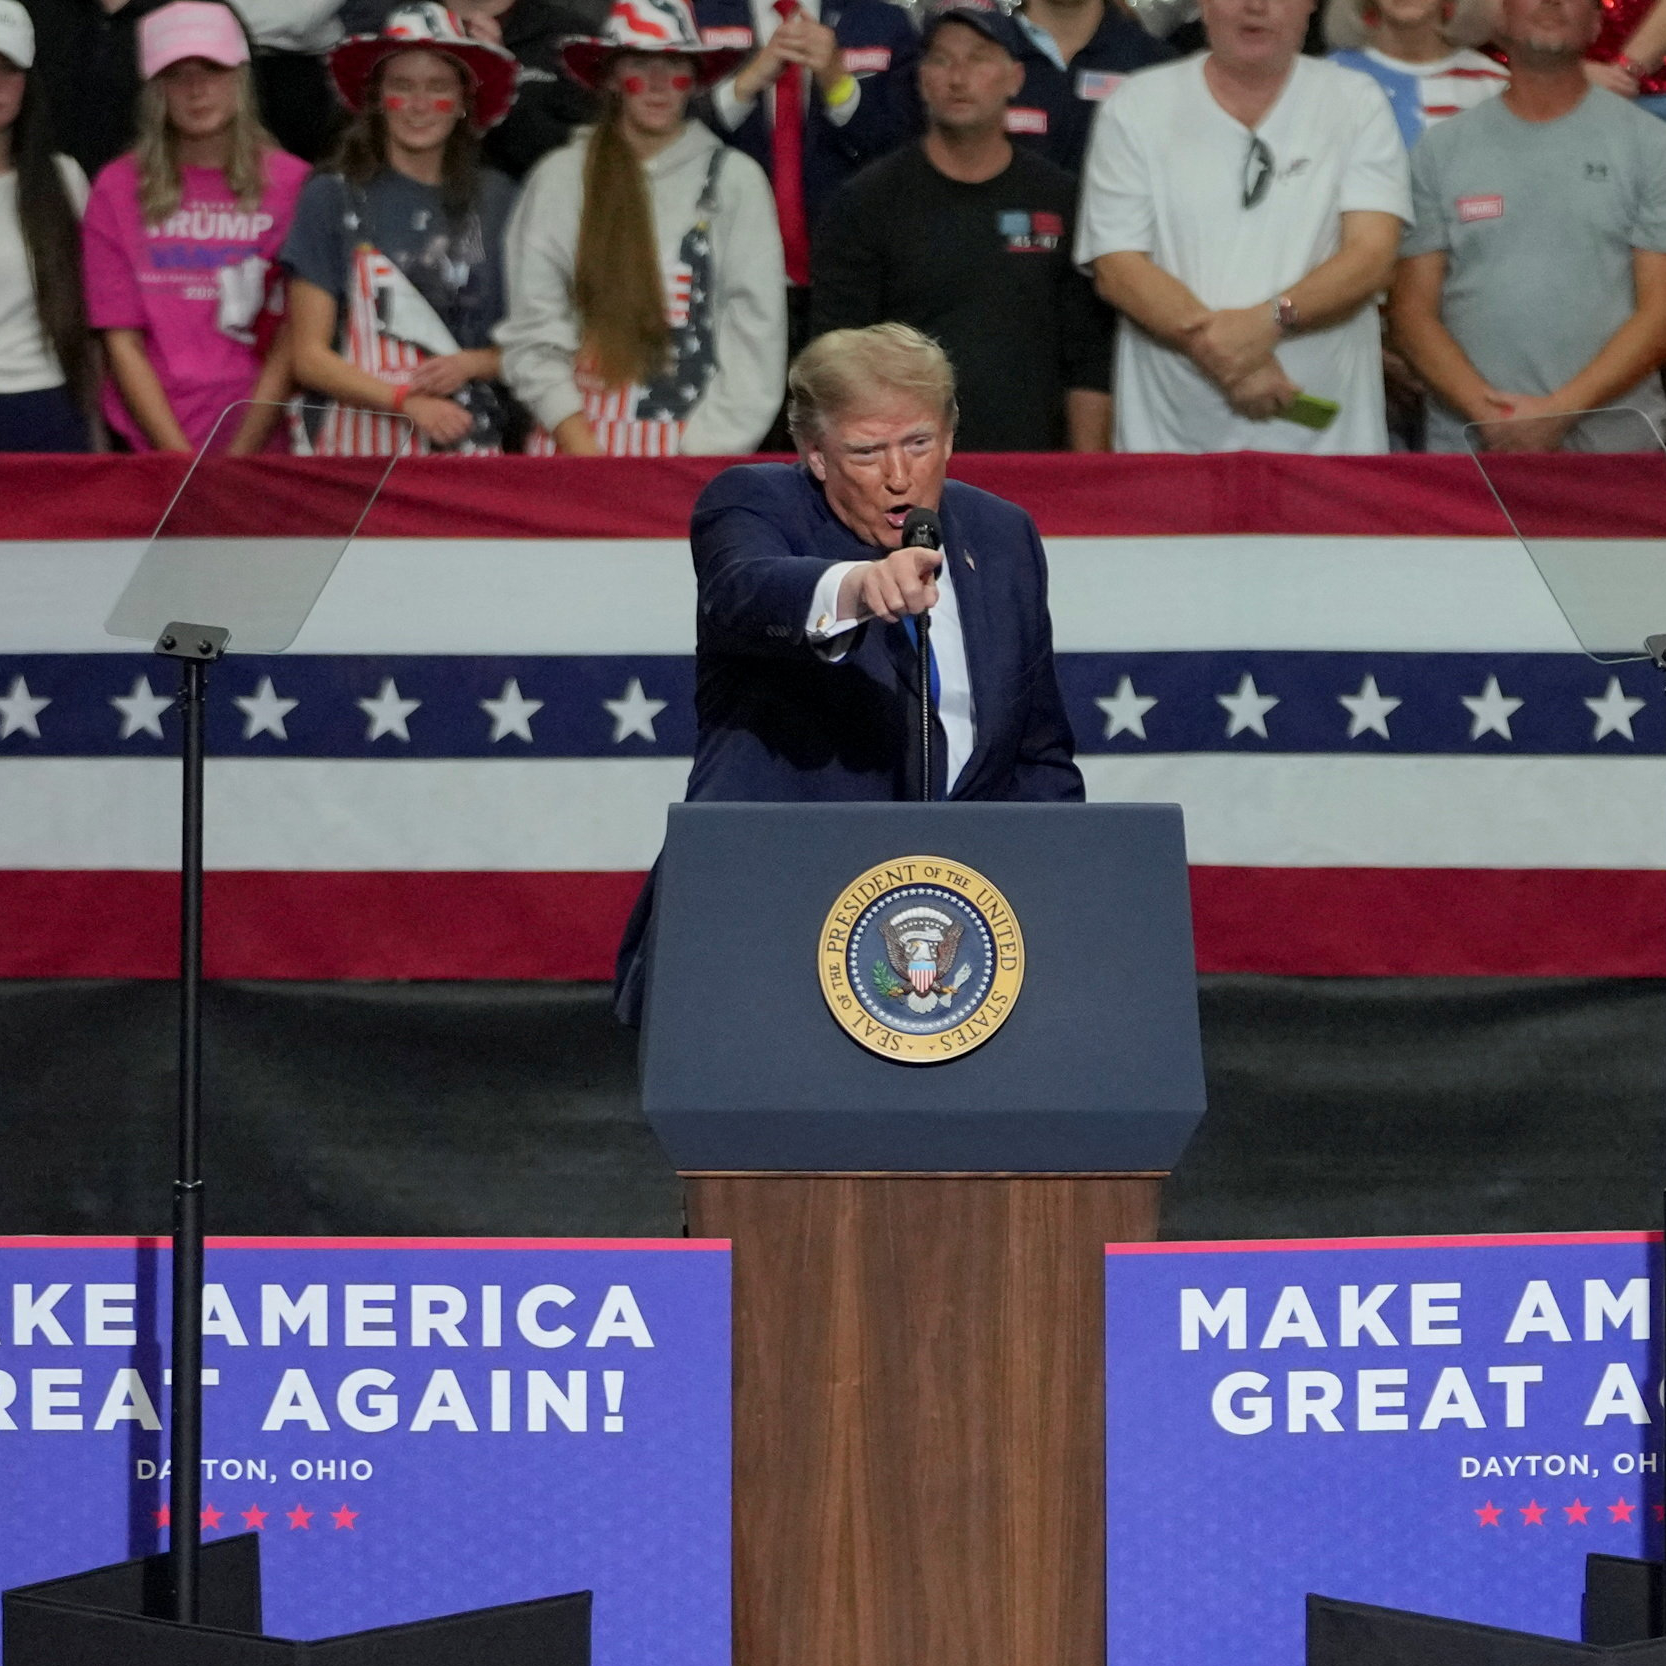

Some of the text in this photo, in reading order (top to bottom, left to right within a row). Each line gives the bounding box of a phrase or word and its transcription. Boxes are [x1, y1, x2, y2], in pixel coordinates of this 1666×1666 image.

[146, 208, 274, 241] RUMP
[827, 864, 1018, 1051] SEAL OF THE PRESIDENT OF THE UNITED STATES
[201, 1284, 655, 1348] AMERICA
[1180, 1282, 1462, 1351] MAKE
[261, 1367, 625, 1433] AGAIN!
[1211, 1364, 1543, 1436] GREAT
[137, 1459, 374, 1484] DATON, OHIO
[1460, 1452, 1657, 1479] DAYTON, OH
